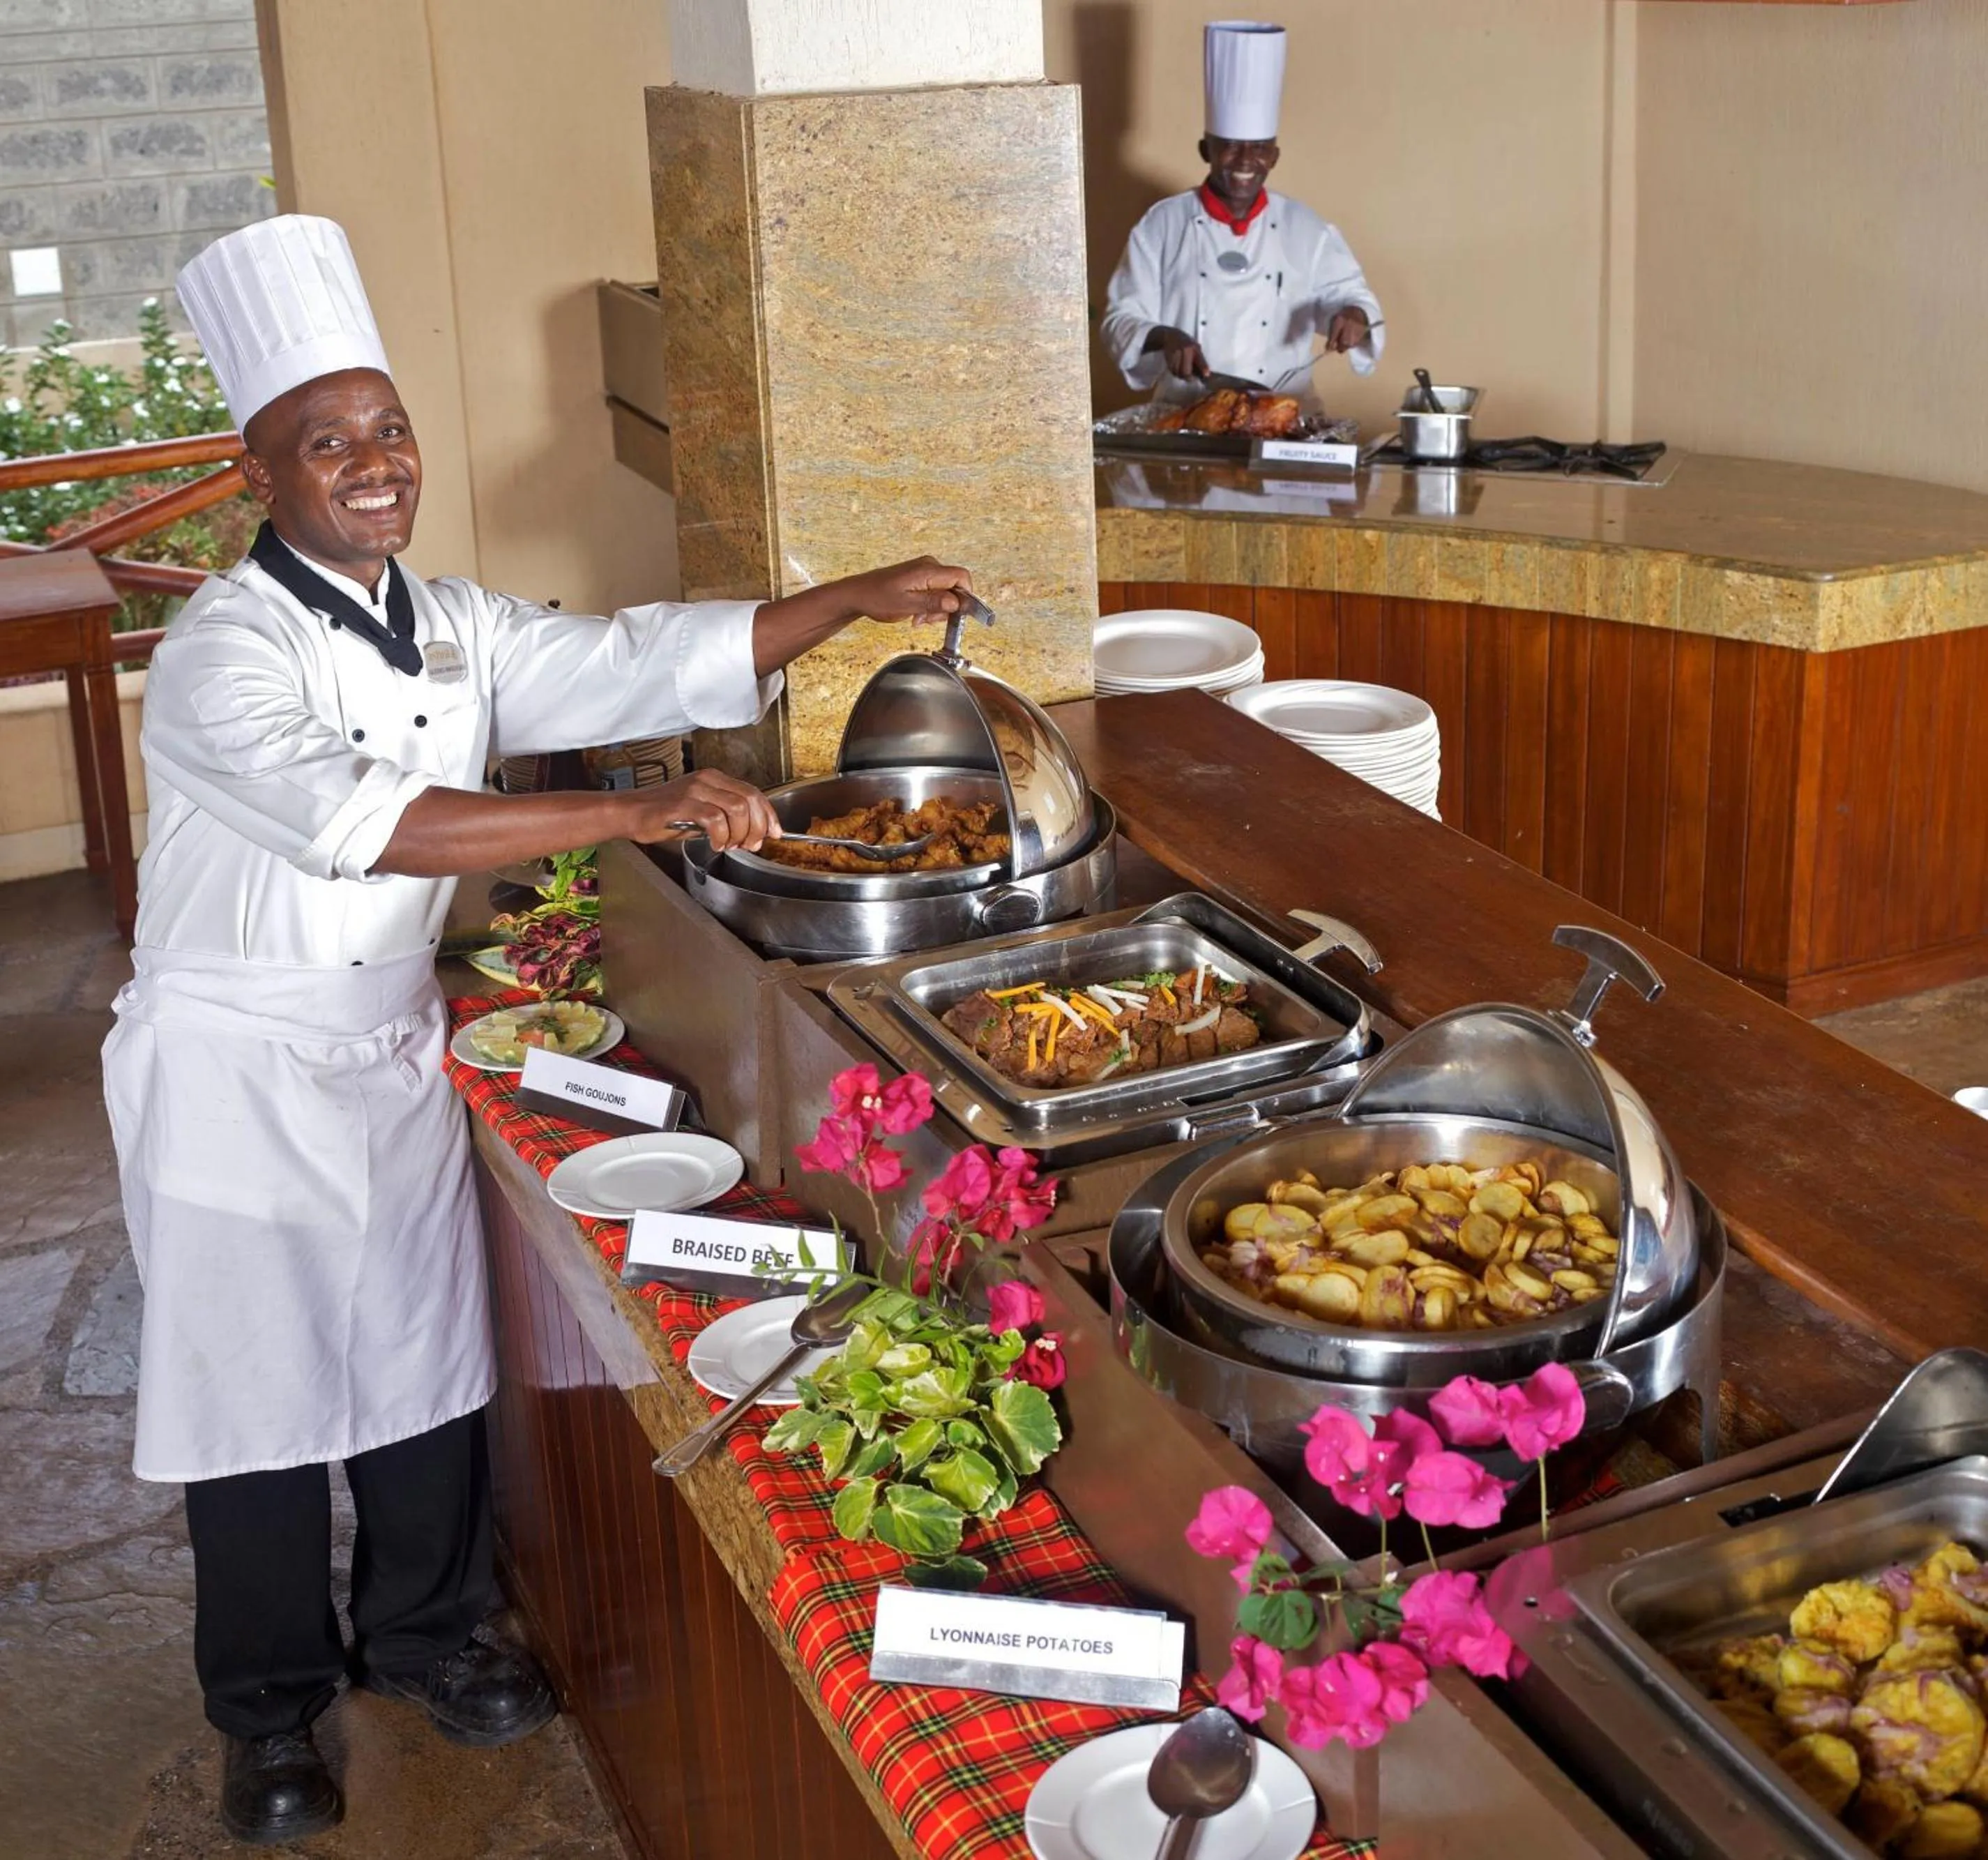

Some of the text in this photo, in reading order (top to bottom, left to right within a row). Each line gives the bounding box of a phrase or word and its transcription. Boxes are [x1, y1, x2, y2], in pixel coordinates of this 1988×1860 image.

[1311, 451, 1337, 460] SAUCE
[565, 1082, 626, 1106] FISH GOUJONS
[672, 1238, 747, 1263] BRAISED
[929, 1627, 1114, 1655] LYONNAISE POTATOES
